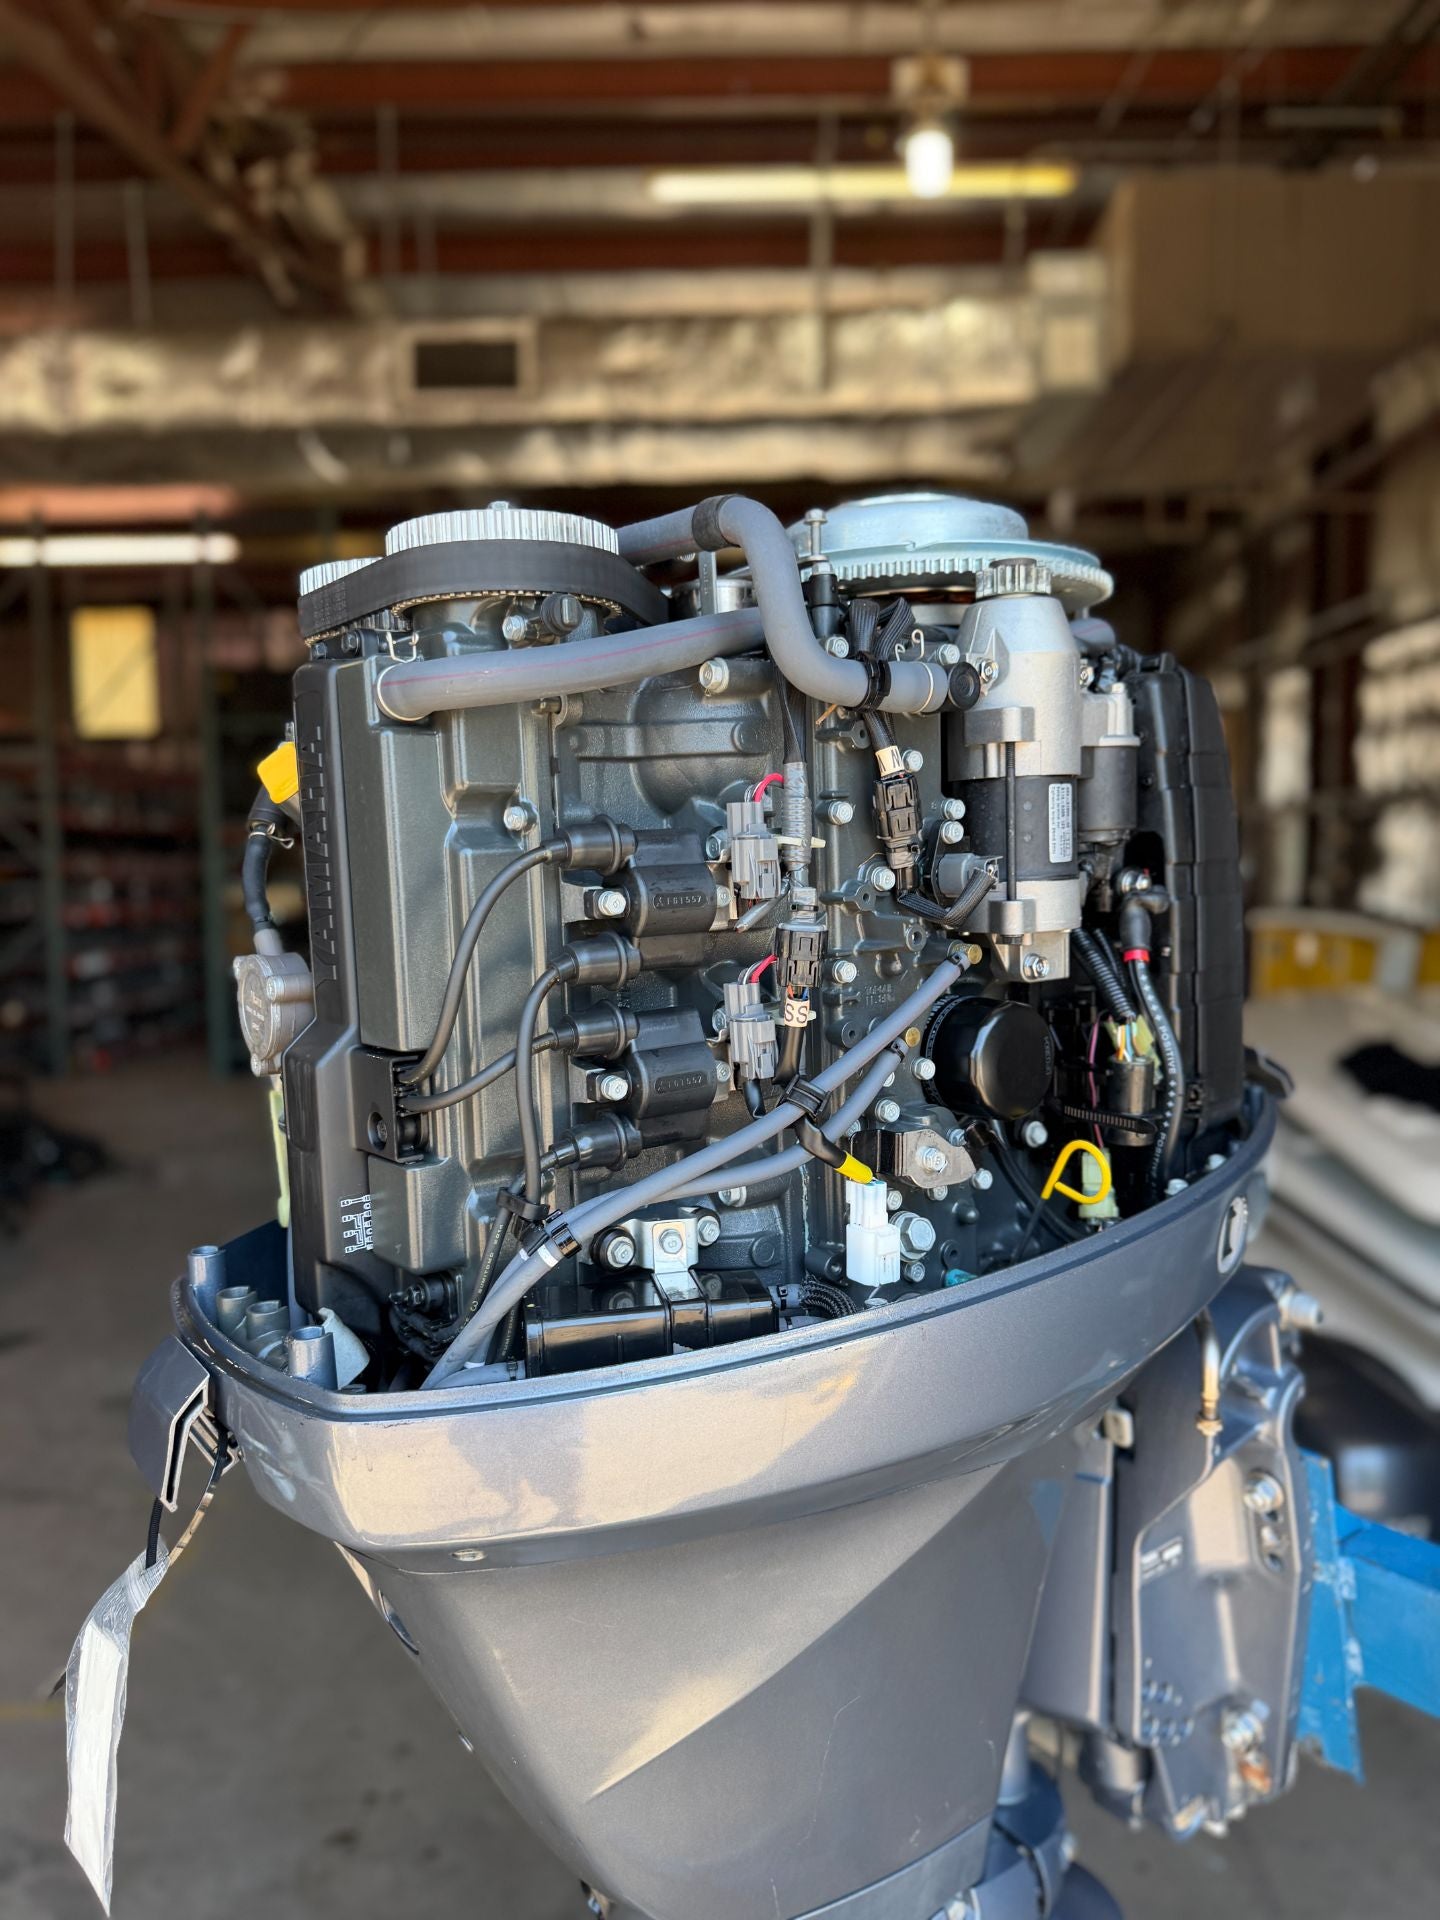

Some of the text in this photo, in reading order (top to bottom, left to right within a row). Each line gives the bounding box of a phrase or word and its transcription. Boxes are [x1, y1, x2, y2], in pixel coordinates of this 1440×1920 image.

[300, 725, 337, 990] YAMAHA
[784, 1003, 808, 1024] SS
[1159, 1025, 1177, 1074] POSITIVE
